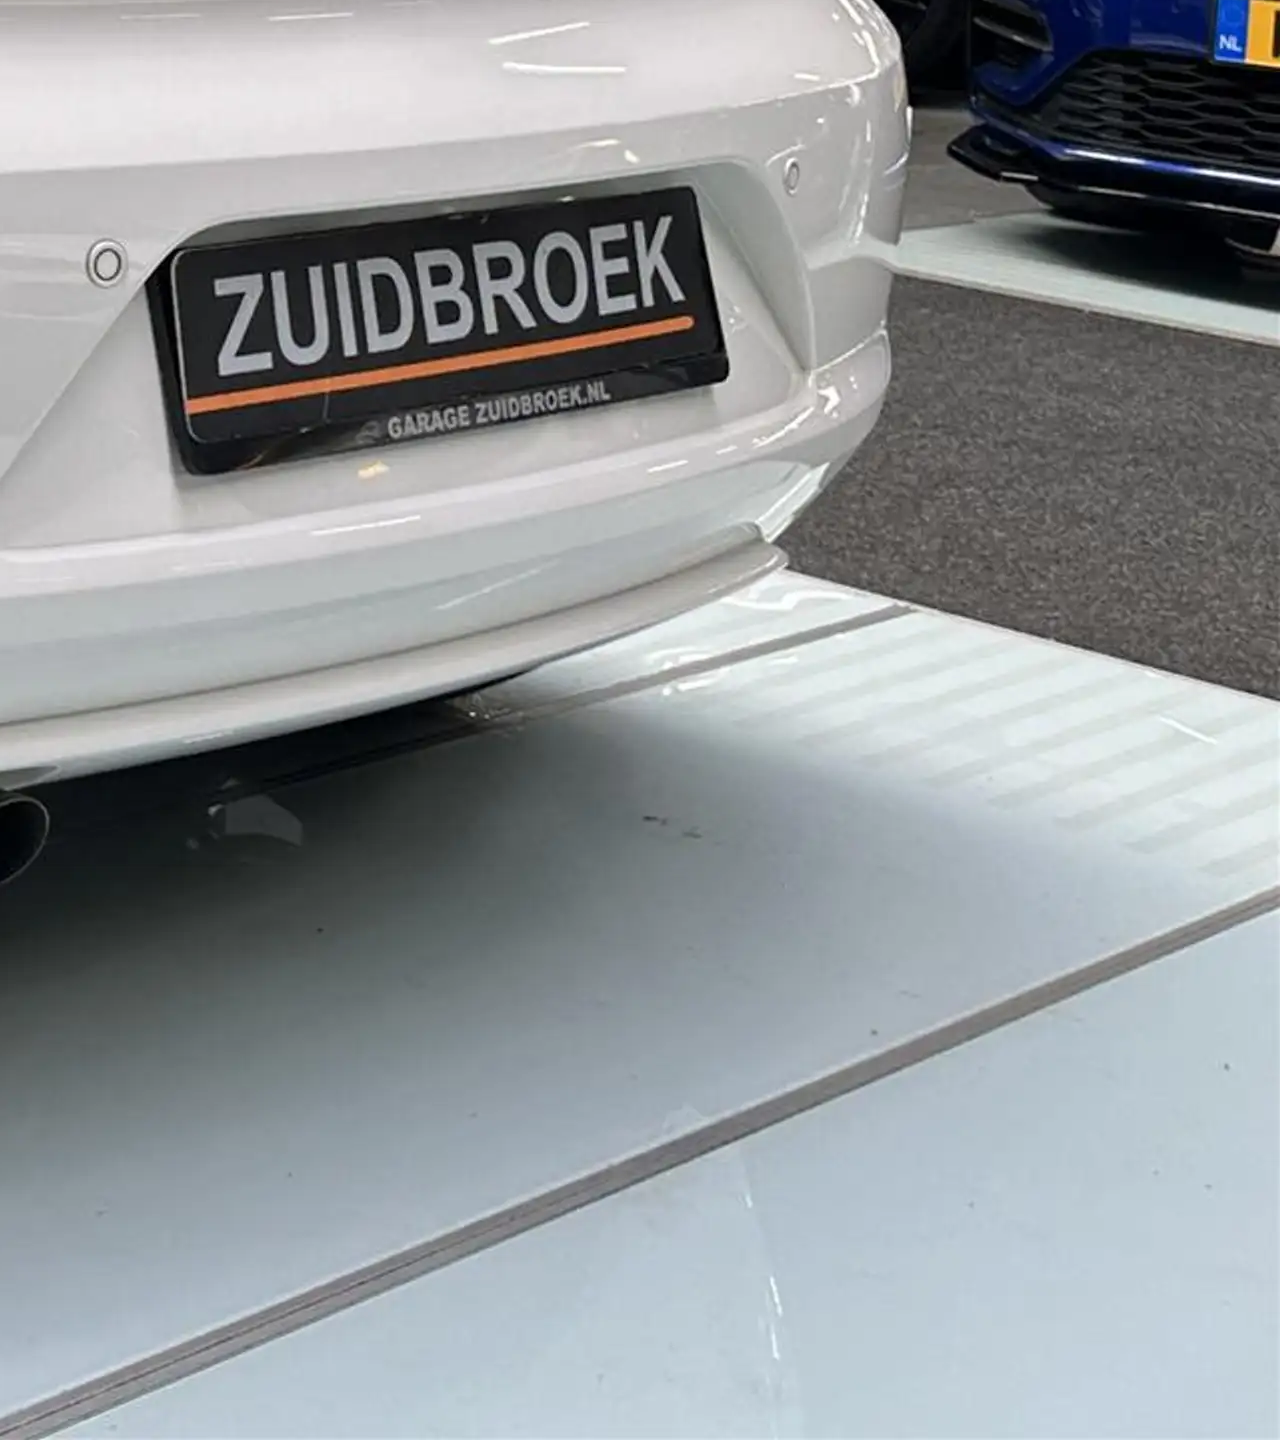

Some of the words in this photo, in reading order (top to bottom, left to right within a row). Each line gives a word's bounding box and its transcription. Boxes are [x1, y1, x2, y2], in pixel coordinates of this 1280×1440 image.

[1219, 33, 1243, 53] NL
[214, 214, 687, 377] ZUIDBROEK
[388, 406, 471, 439] GARAGE
[474, 380, 612, 426] ZUIDBROEK.NL
